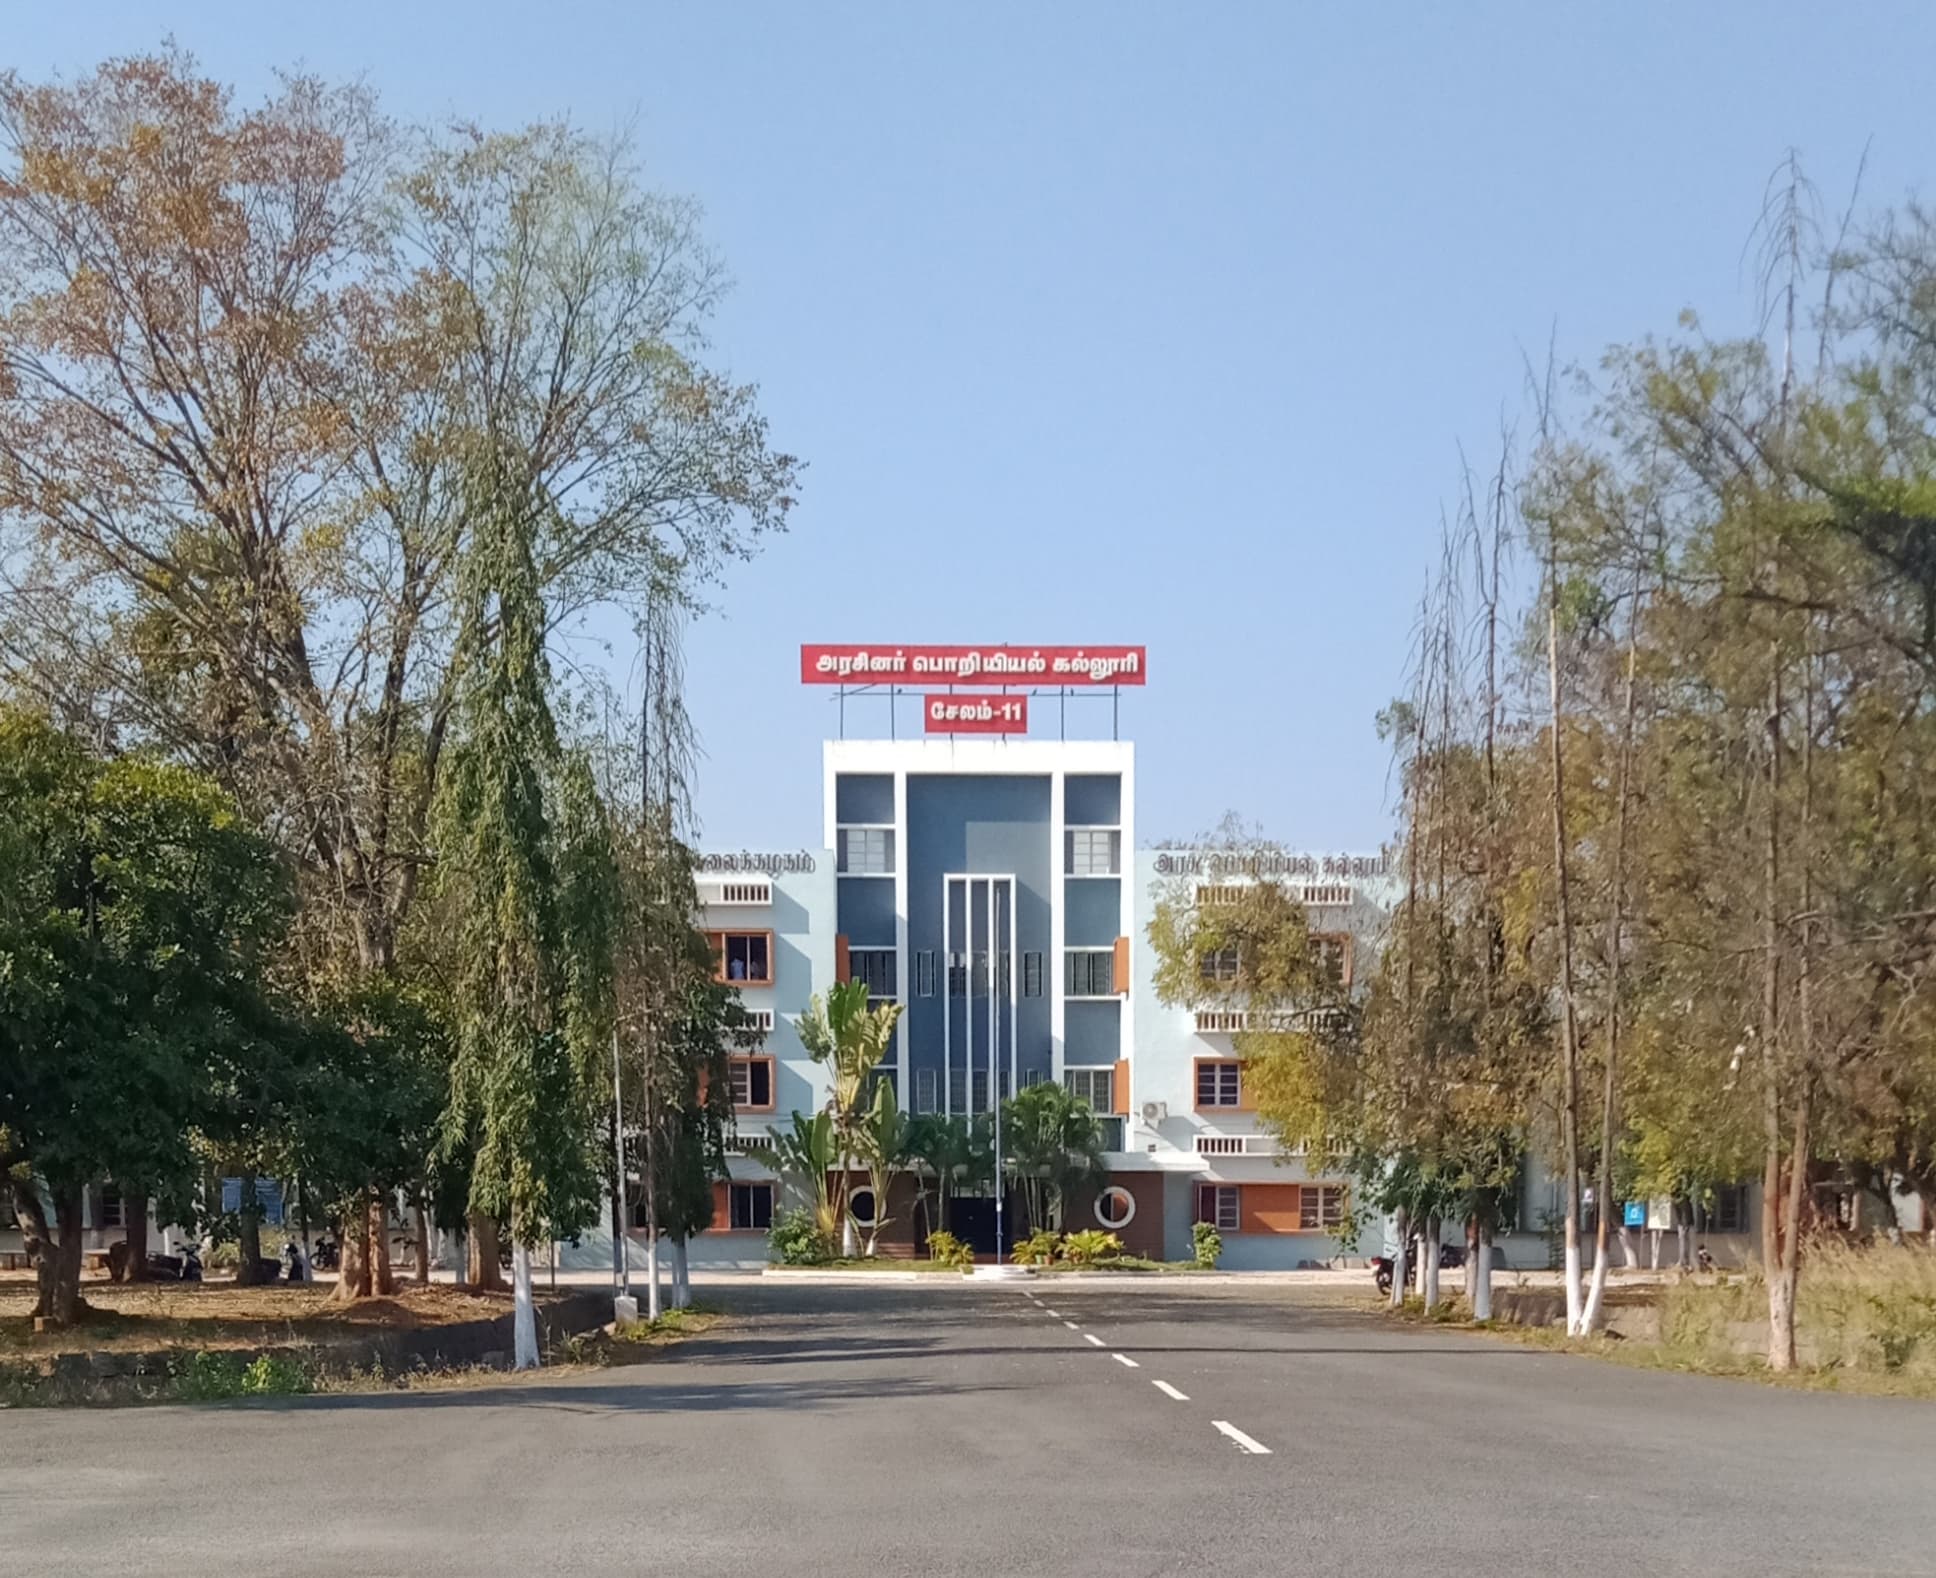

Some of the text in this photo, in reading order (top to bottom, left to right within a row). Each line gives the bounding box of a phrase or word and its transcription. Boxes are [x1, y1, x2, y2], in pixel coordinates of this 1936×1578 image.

[816, 650, 1139, 681] அரசினர் பொறியியல் கல்லூரி
[930, 699, 1022, 721] சேலம்-11
